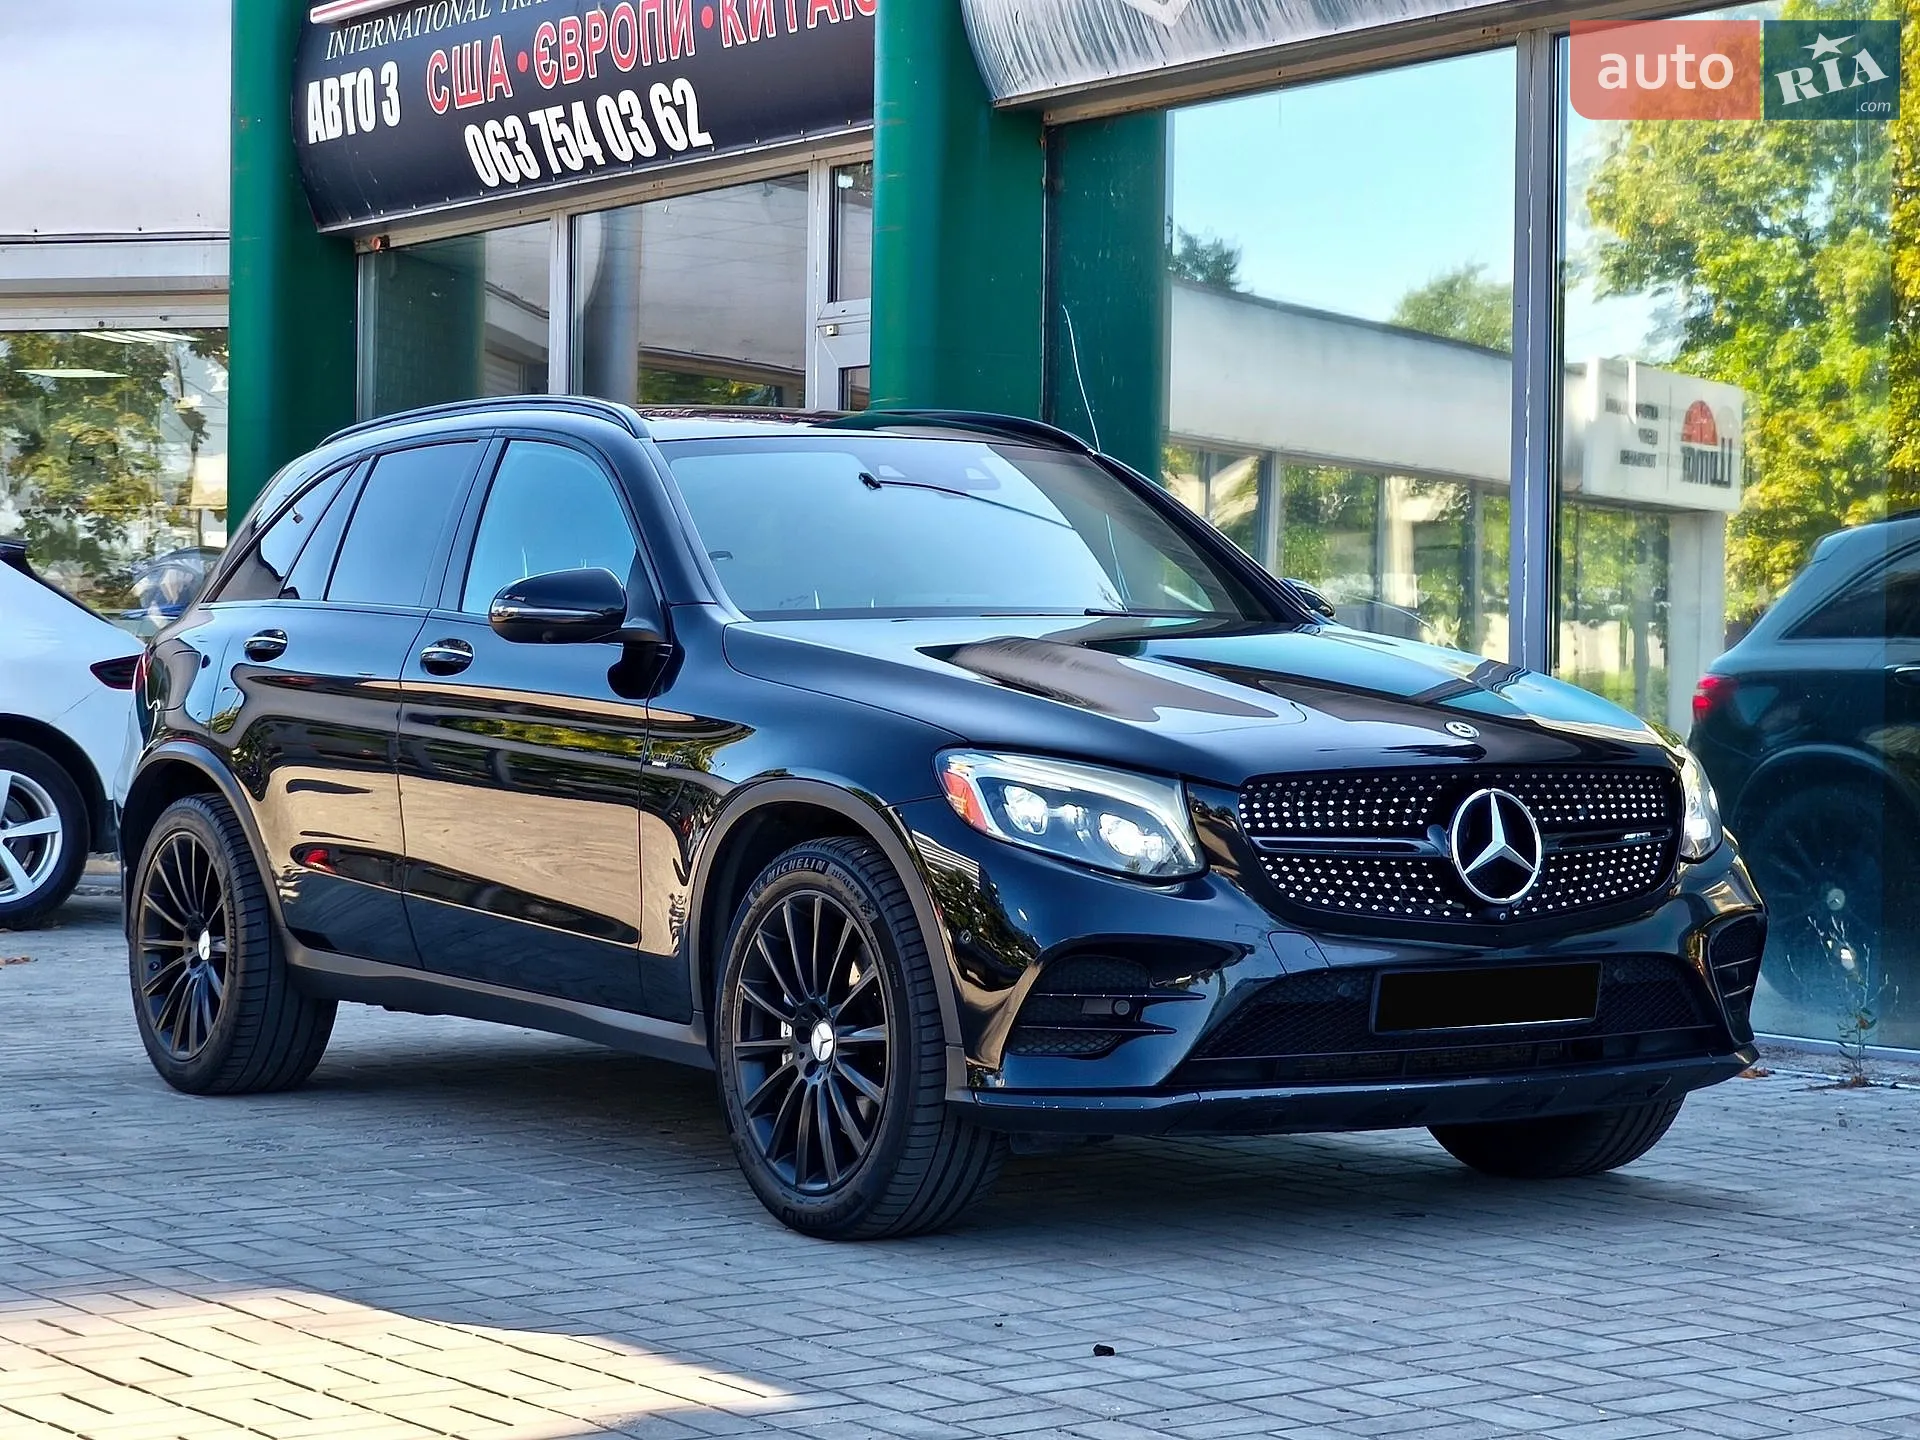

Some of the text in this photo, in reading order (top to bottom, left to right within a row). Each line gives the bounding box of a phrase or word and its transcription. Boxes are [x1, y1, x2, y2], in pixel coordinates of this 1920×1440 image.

[308, 67, 376, 144] АВТО
[426, 34, 513, 115] США
[534, 0, 696, 89] ЄВРОПИ
[720, 0, 875, 48] КИТ
[325, 0, 492, 60] INTERNATIONAL
[464, 78, 714, 188] 063 754 03 62
[766, 857, 826, 883] MICHELIN
